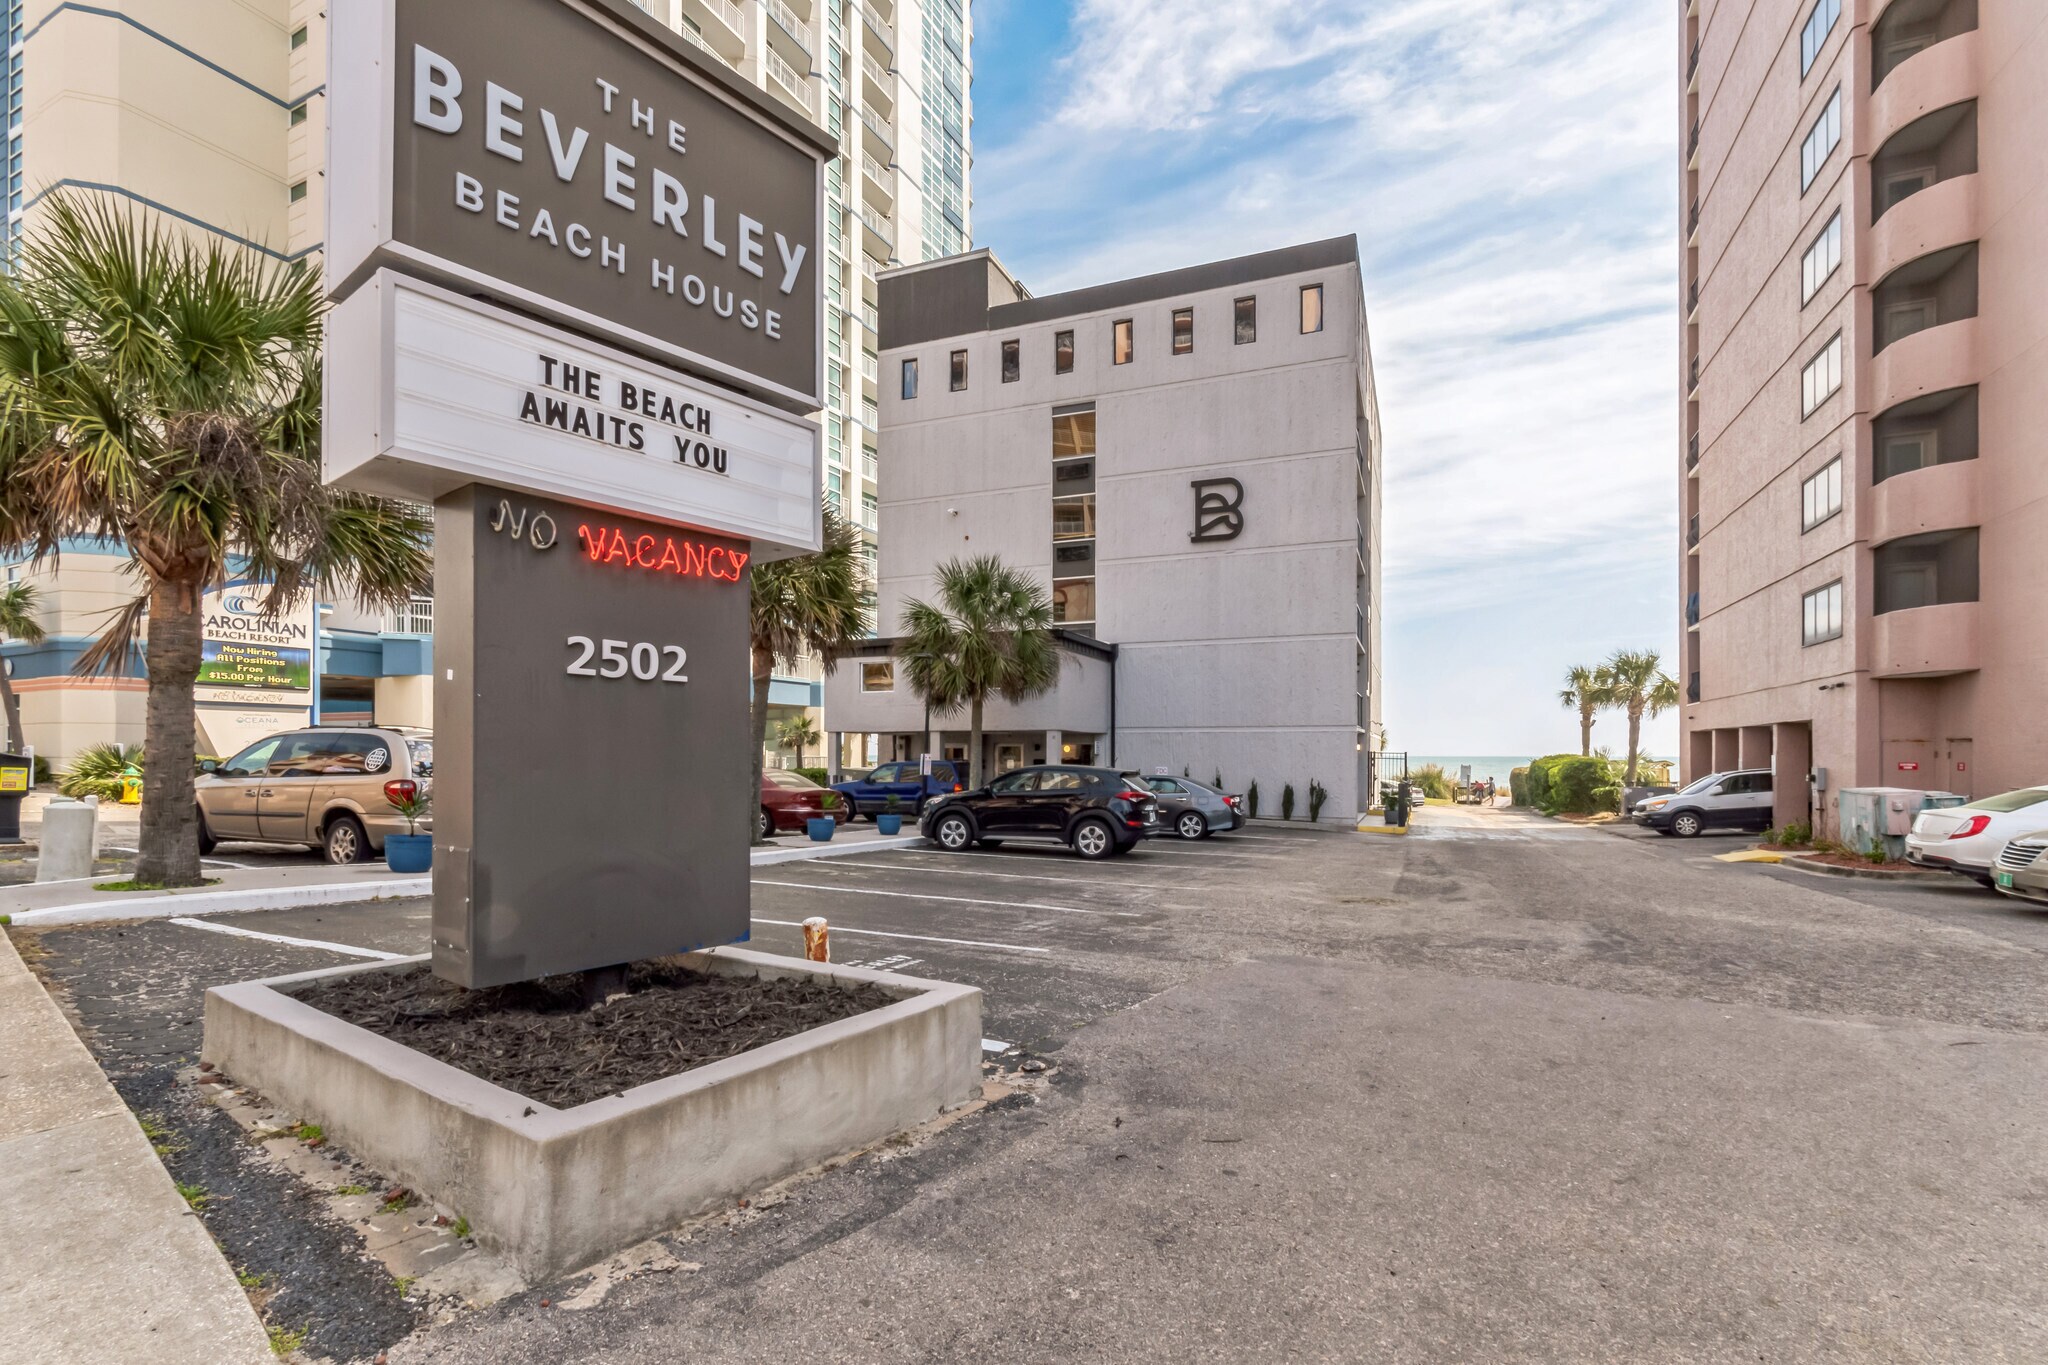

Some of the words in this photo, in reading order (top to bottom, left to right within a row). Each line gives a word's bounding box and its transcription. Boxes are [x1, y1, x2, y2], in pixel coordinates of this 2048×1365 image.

[595, 77, 686, 154] THE
[414, 43, 807, 295] BEVERLEY
[456, 171, 626, 274] BEACH
[652, 258, 781, 339] HOUSE
[539, 354, 600, 401] THE
[621, 381, 711, 435] BEACH
[520, 391, 644, 450] AWAITS
[674, 435, 727, 473] YOU
[490, 499, 557, 549] NO
[578, 525, 748, 582] VACANCY
[208, 629, 246, 640] BEACH
[250, 633, 291, 644] RESORT
[216, 653, 234, 662] All
[236, 656, 286, 666] Positions
[223, 645, 244, 654] Now
[247, 647, 278, 657] Hiring
[566, 636, 688, 683] 2502
[209, 672, 244, 681] $15.00
[247, 674, 265, 682] Per
[268, 675, 292, 684] Hour
[237, 665, 263, 673] From
